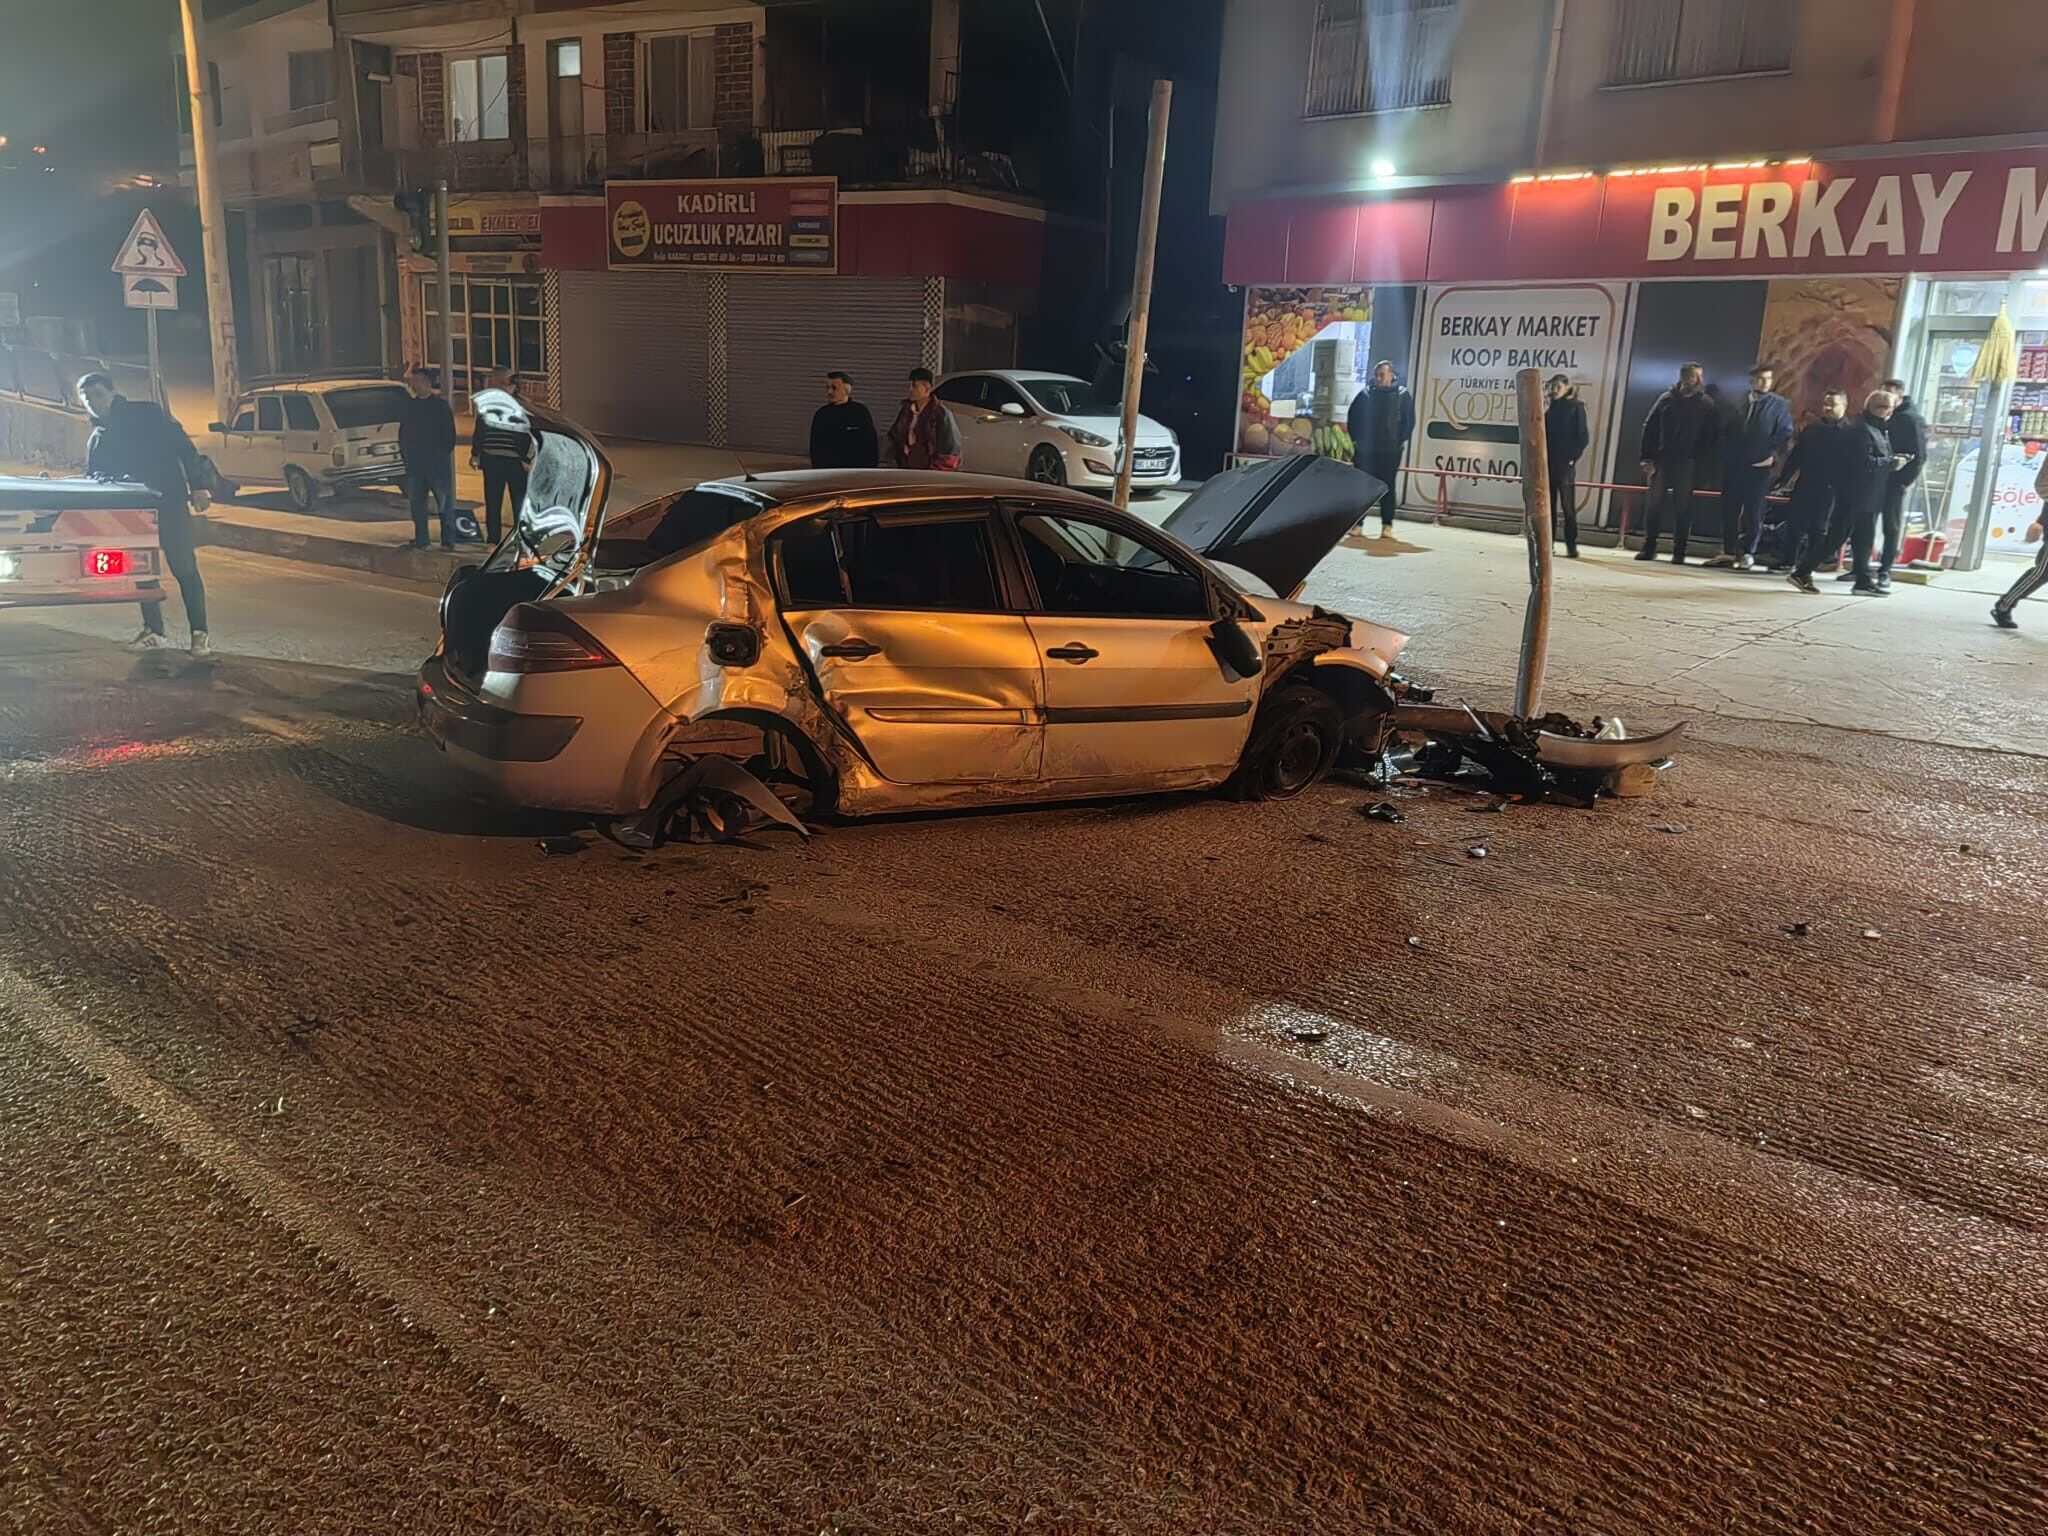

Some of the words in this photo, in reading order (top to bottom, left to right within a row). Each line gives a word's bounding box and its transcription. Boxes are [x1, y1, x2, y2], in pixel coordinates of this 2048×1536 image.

[677, 191, 756, 214] KADİRLİ
[1646, 169, 1973, 261] BERKAY
[653, 223, 722, 246] UCUZLUK
[725, 223, 783, 246] PAZARI
[1440, 316, 1512, 337] BERKAY
[1516, 315, 1601, 337] MARKET
[1450, 348, 1502, 367] KOOP
[1507, 349, 1579, 369] BAKKAL
[1460, 377, 1500, 390] TÜRKİYE
[1434, 455, 1481, 486] SATIŞ
